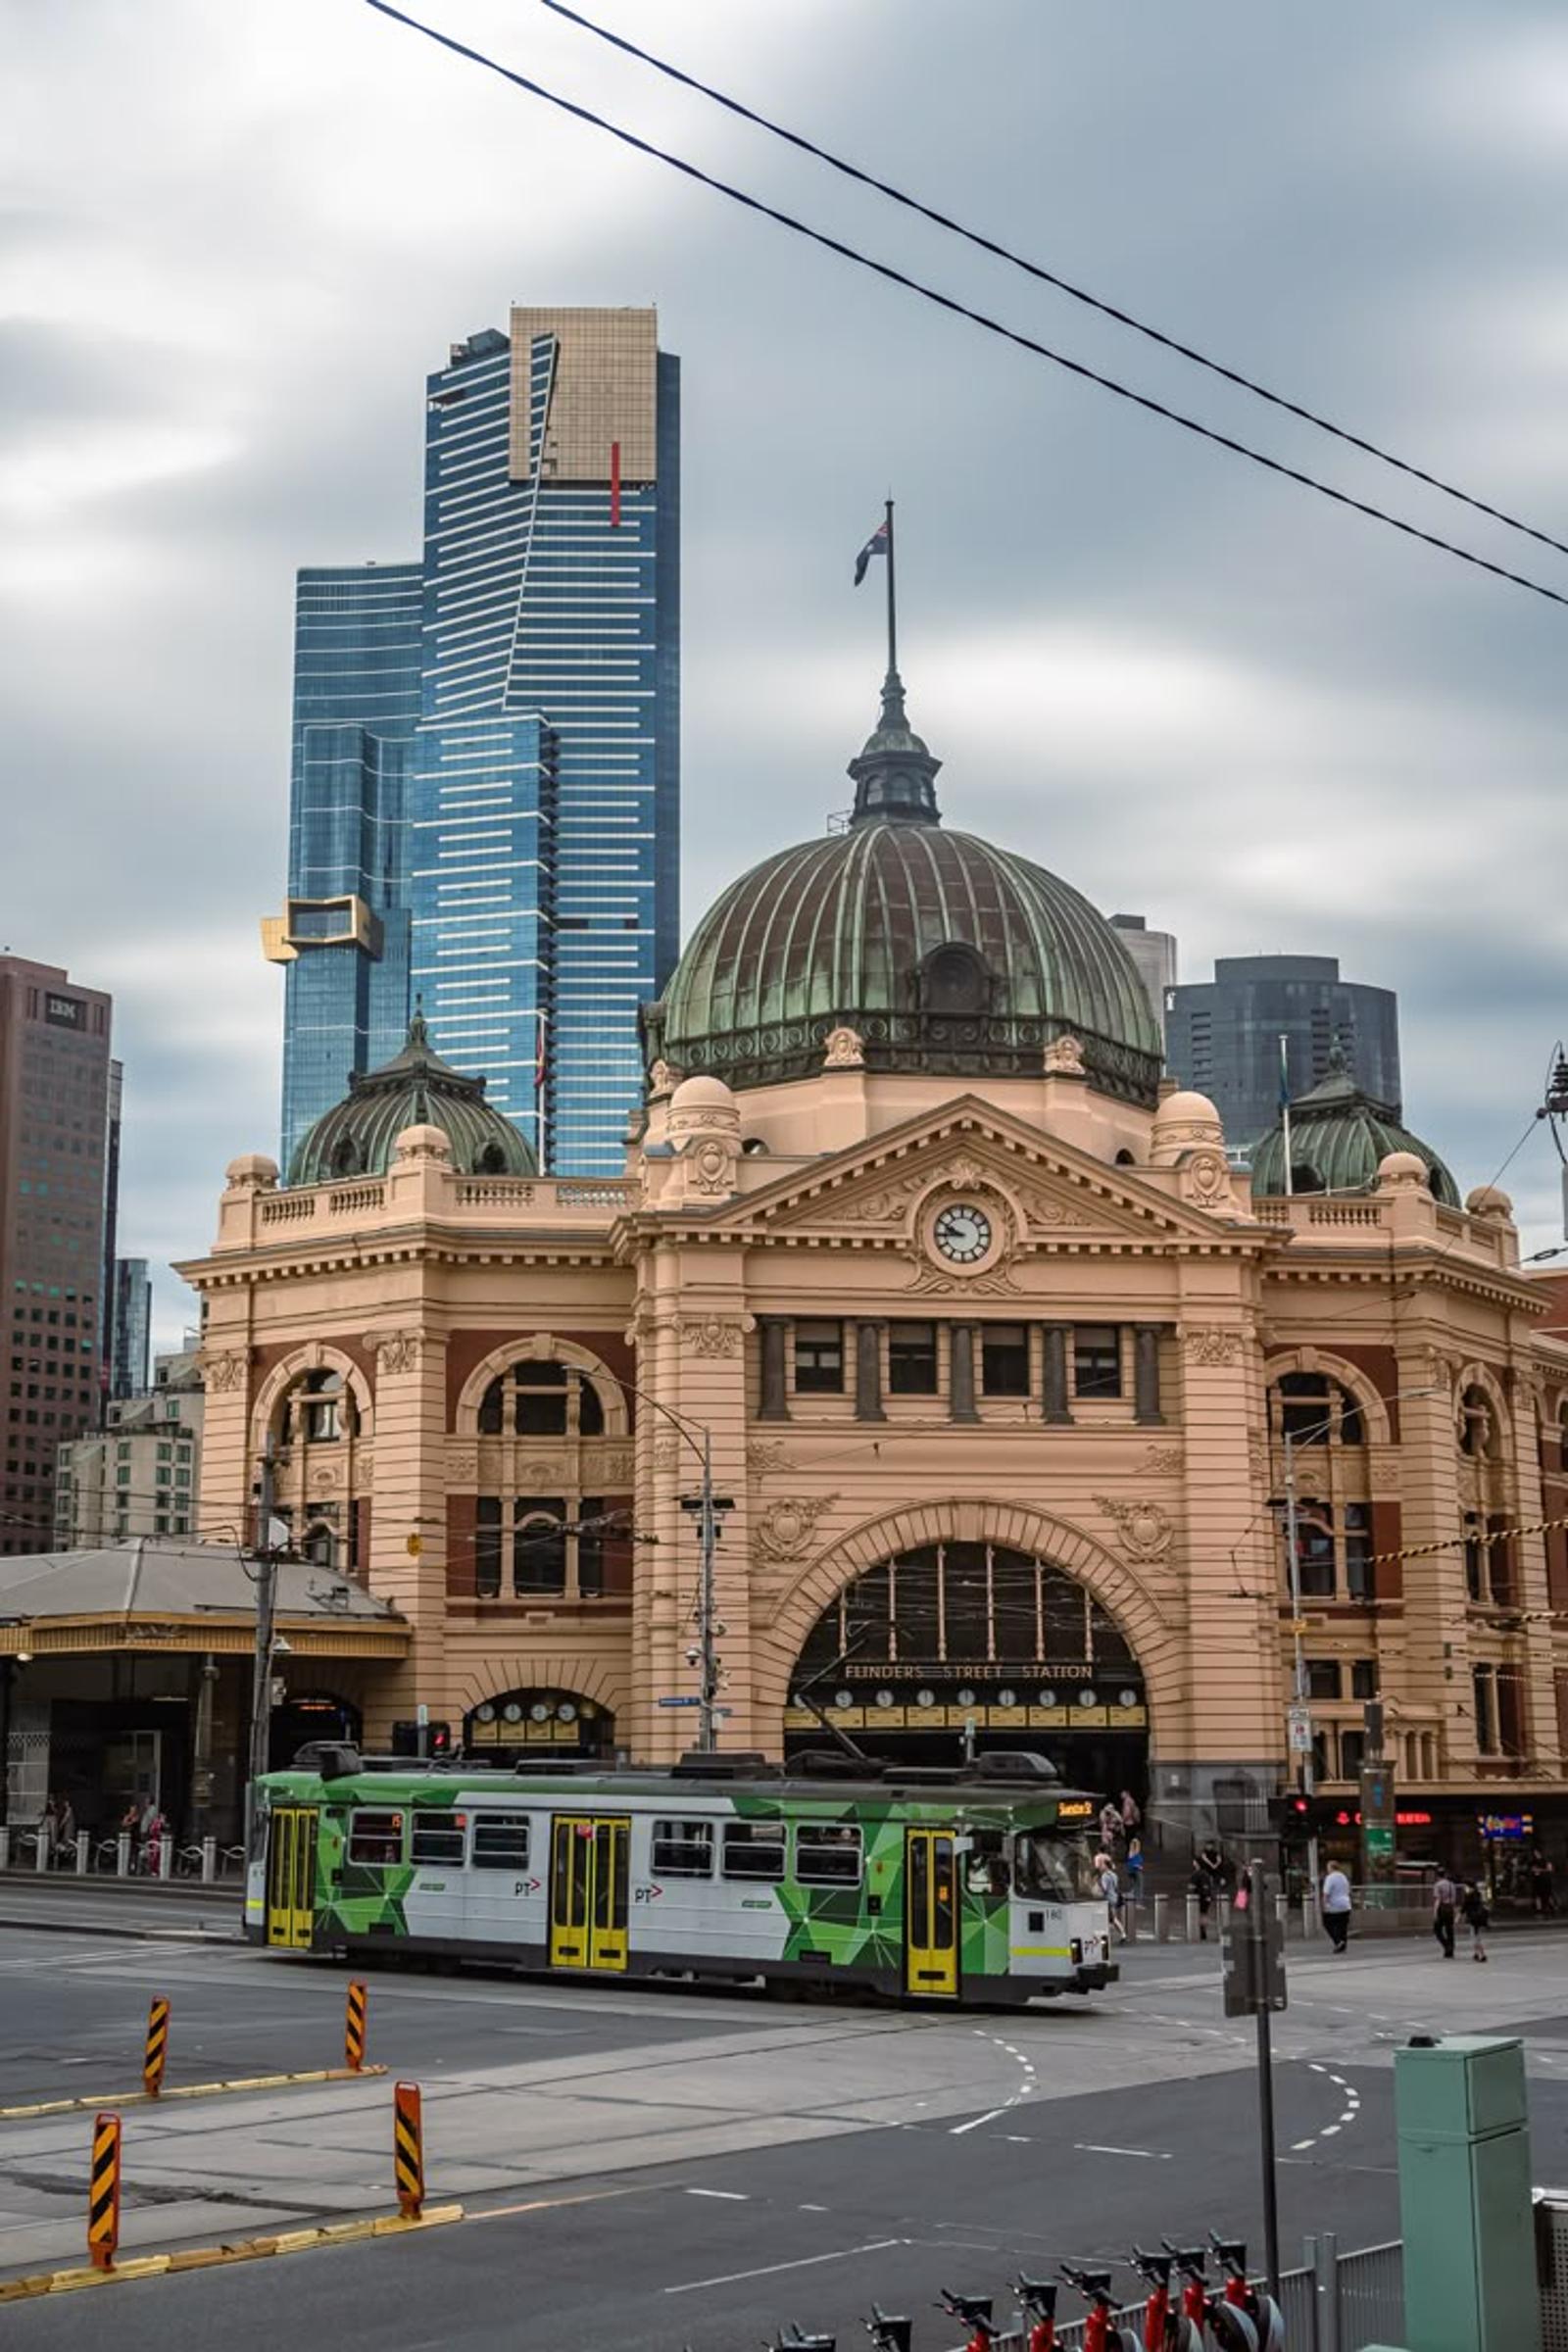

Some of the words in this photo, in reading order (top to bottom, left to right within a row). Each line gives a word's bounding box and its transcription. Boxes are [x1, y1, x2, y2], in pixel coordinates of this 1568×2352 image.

[50, 1000, 75, 1018] IBM
[845, 1666, 923, 1679] FLINDERS
[943, 1666, 1003, 1679] STREET
[1022, 1666, 1093, 1679] STATION
